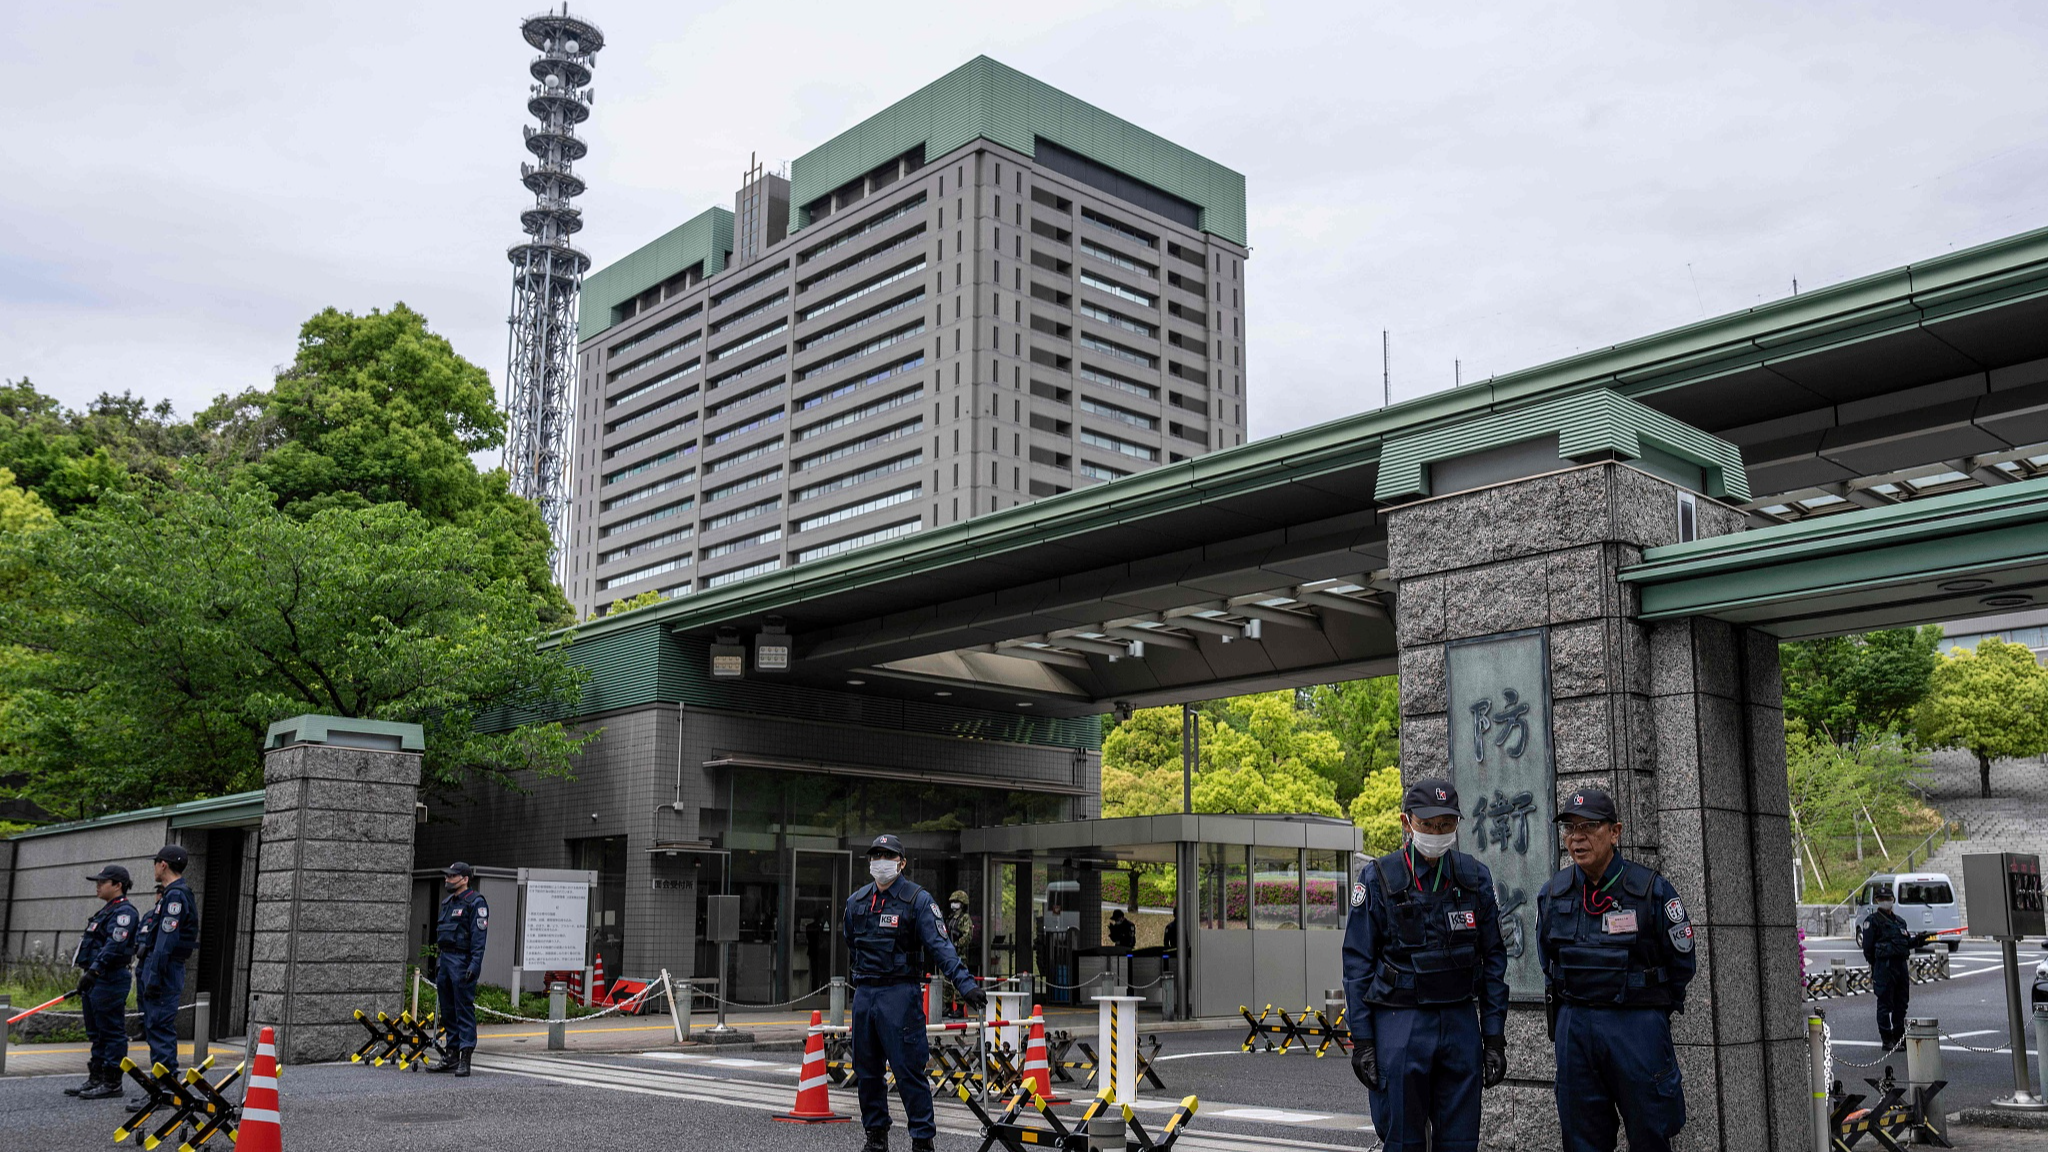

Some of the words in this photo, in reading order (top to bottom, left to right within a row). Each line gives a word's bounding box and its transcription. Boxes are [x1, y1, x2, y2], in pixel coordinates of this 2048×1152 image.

[655, 879, 694, 890] 面会受付所
[881, 915, 898, 924] KSS
[1451, 913, 1474, 925] KSS
[1672, 926, 1692, 941] KSS
